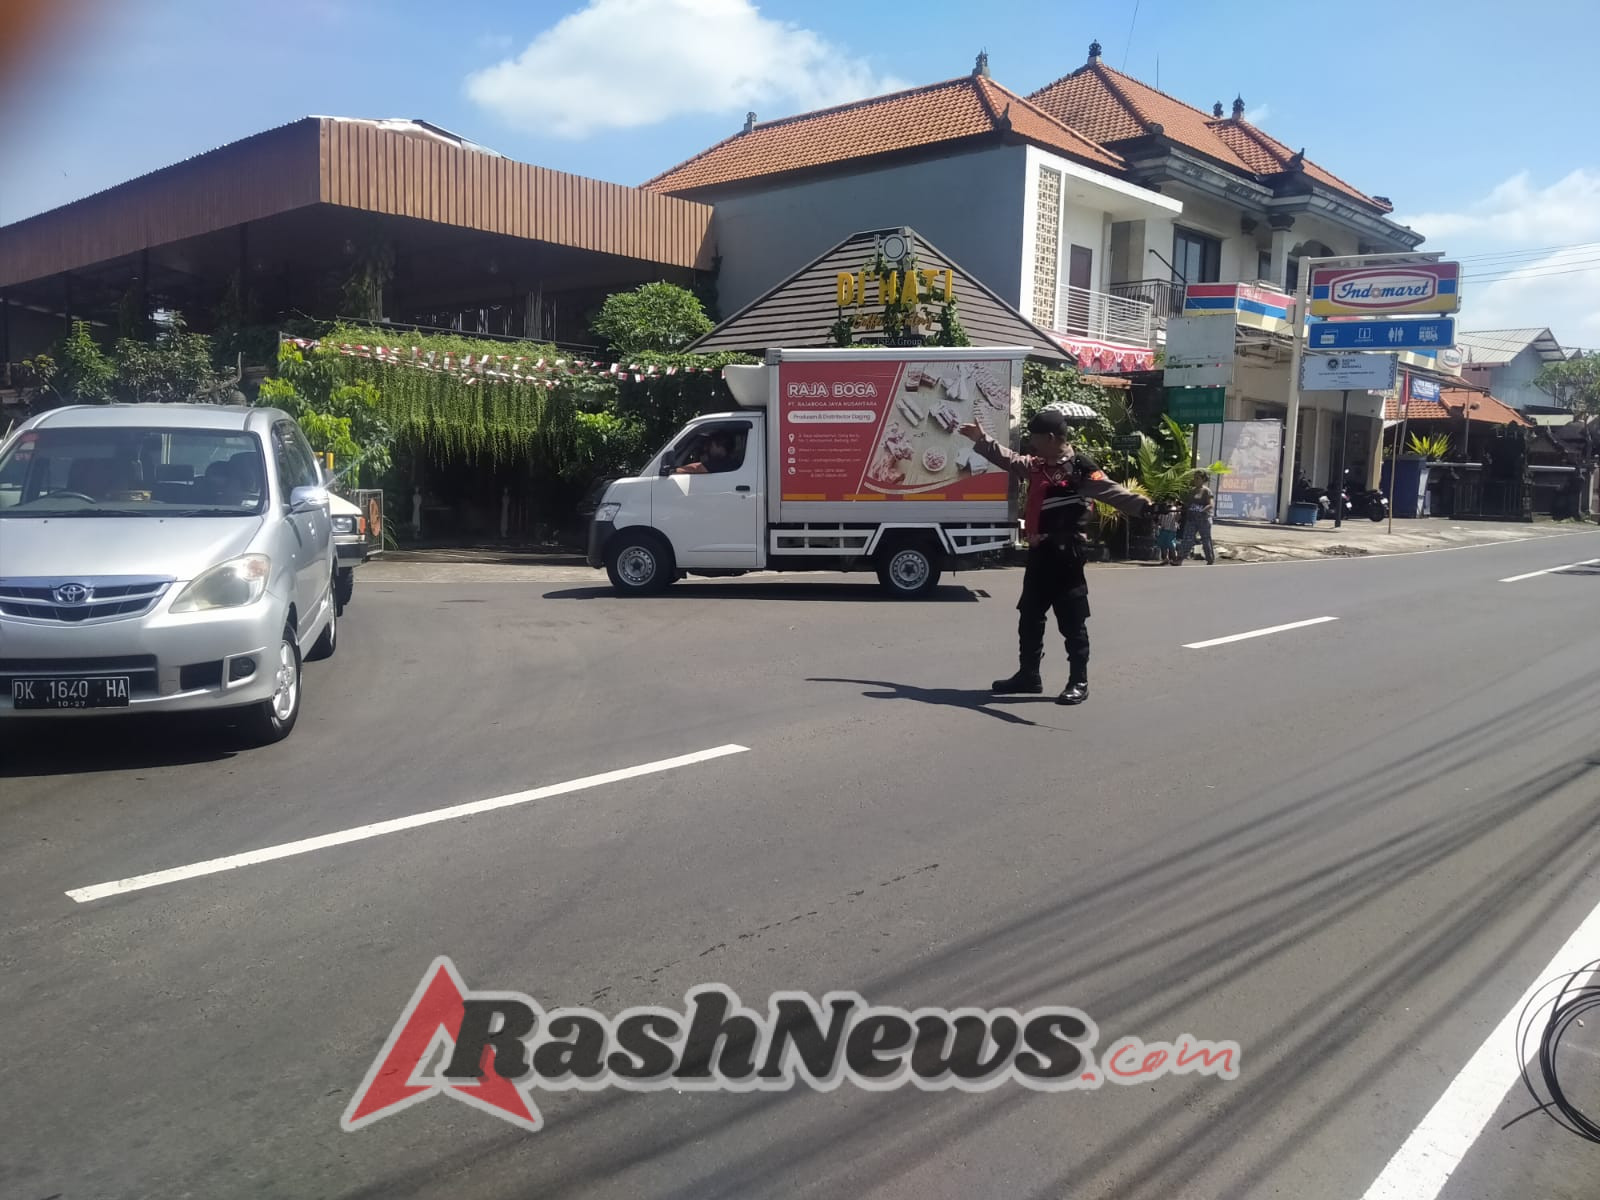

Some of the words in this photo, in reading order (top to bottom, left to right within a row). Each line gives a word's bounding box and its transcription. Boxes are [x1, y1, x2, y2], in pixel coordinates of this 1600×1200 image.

[1337, 281, 1429, 299] Indomaret
[788, 383, 828, 397] RAJA
[832, 382, 877, 397] BOGA
[14, 681, 35, 699] DK
[49, 680, 88, 699] 1640
[106, 679, 127, 698] HA
